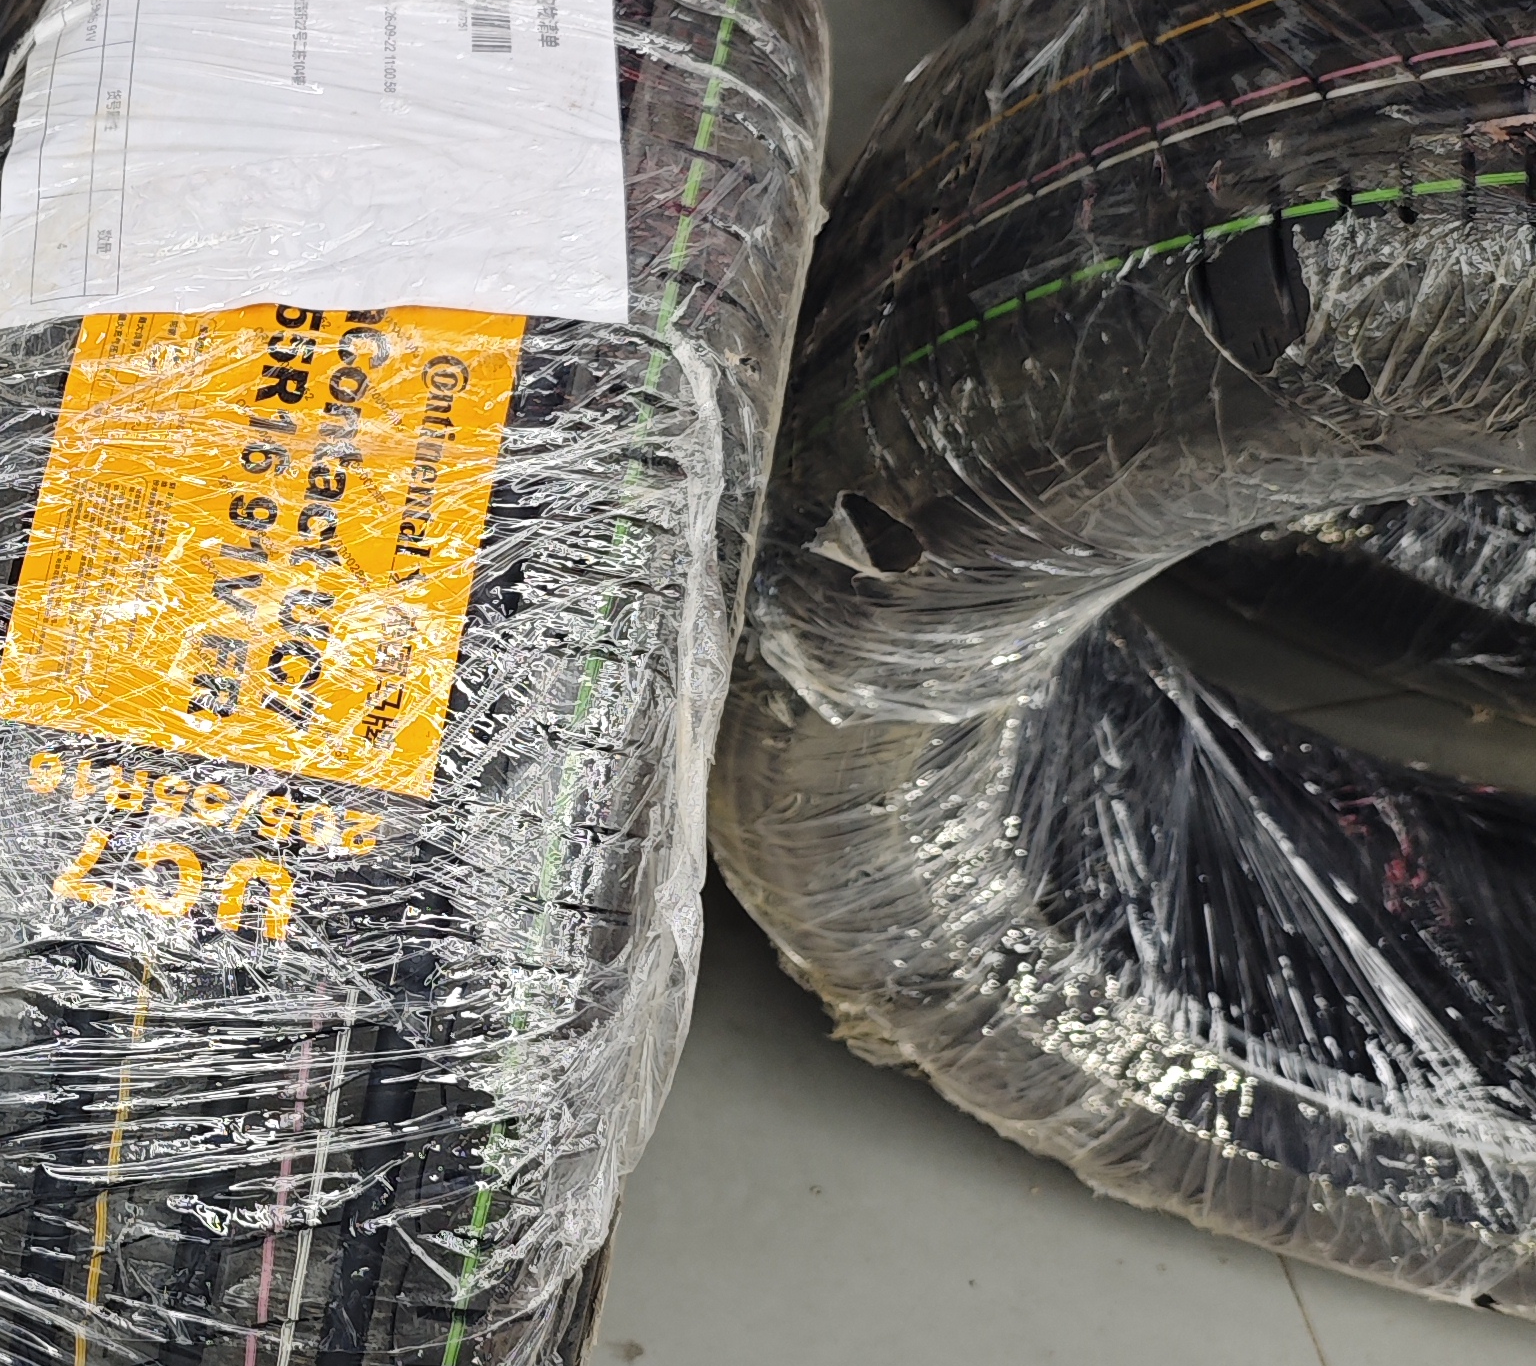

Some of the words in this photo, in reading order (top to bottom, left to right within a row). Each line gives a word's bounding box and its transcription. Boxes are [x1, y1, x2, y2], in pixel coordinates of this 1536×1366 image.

[85, 23, 98, 43] 91V
[95, 228, 113, 255] 数量
[395, 353, 469, 558] Continental
[210, 495, 279, 626] 91V
[187, 633, 251, 718] FR
[259, 587, 337, 732] UC7
[27, 749, 384, 856] 205/55R16
[51, 828, 294, 941] UC7
